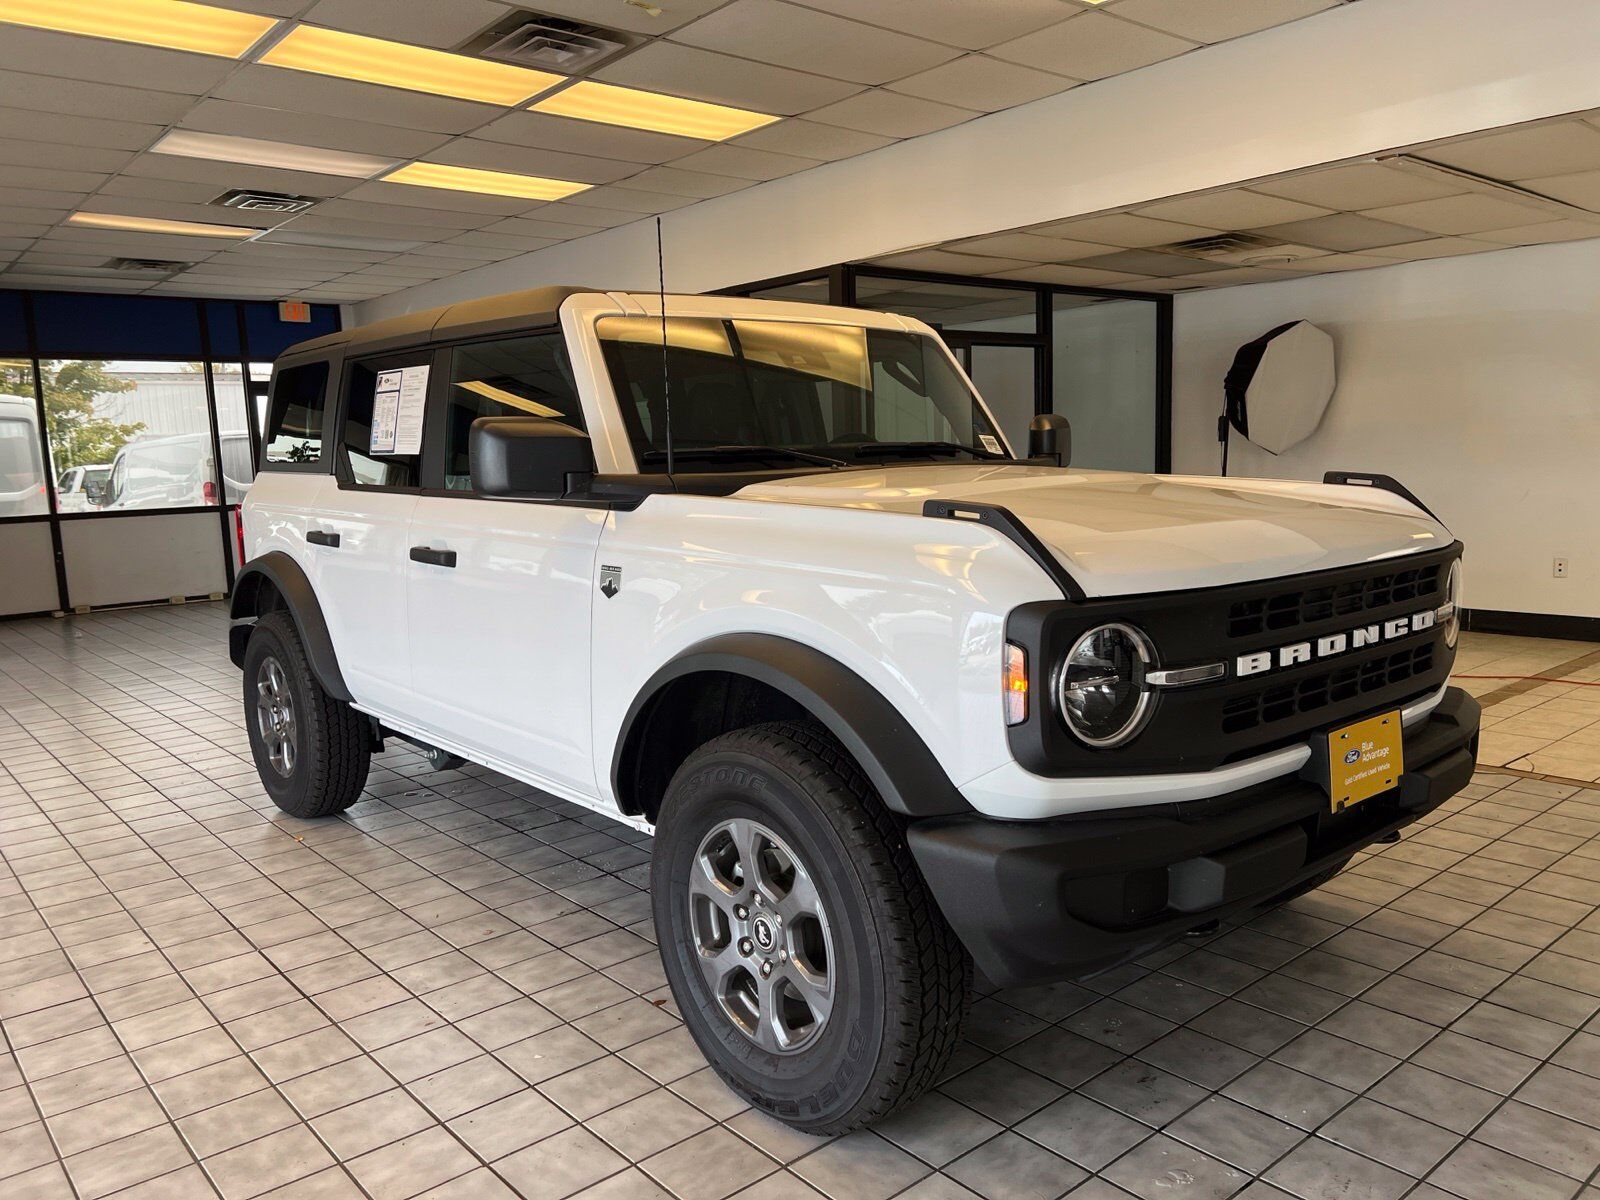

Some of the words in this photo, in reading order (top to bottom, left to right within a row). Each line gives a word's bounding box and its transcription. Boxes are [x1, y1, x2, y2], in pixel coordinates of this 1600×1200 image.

[1236, 610, 1435, 677] BRONCO
[1361, 741, 1374, 752] Blue
[1345, 750, 1360, 764] Ford
[1362, 747, 1390, 762] Advantage
